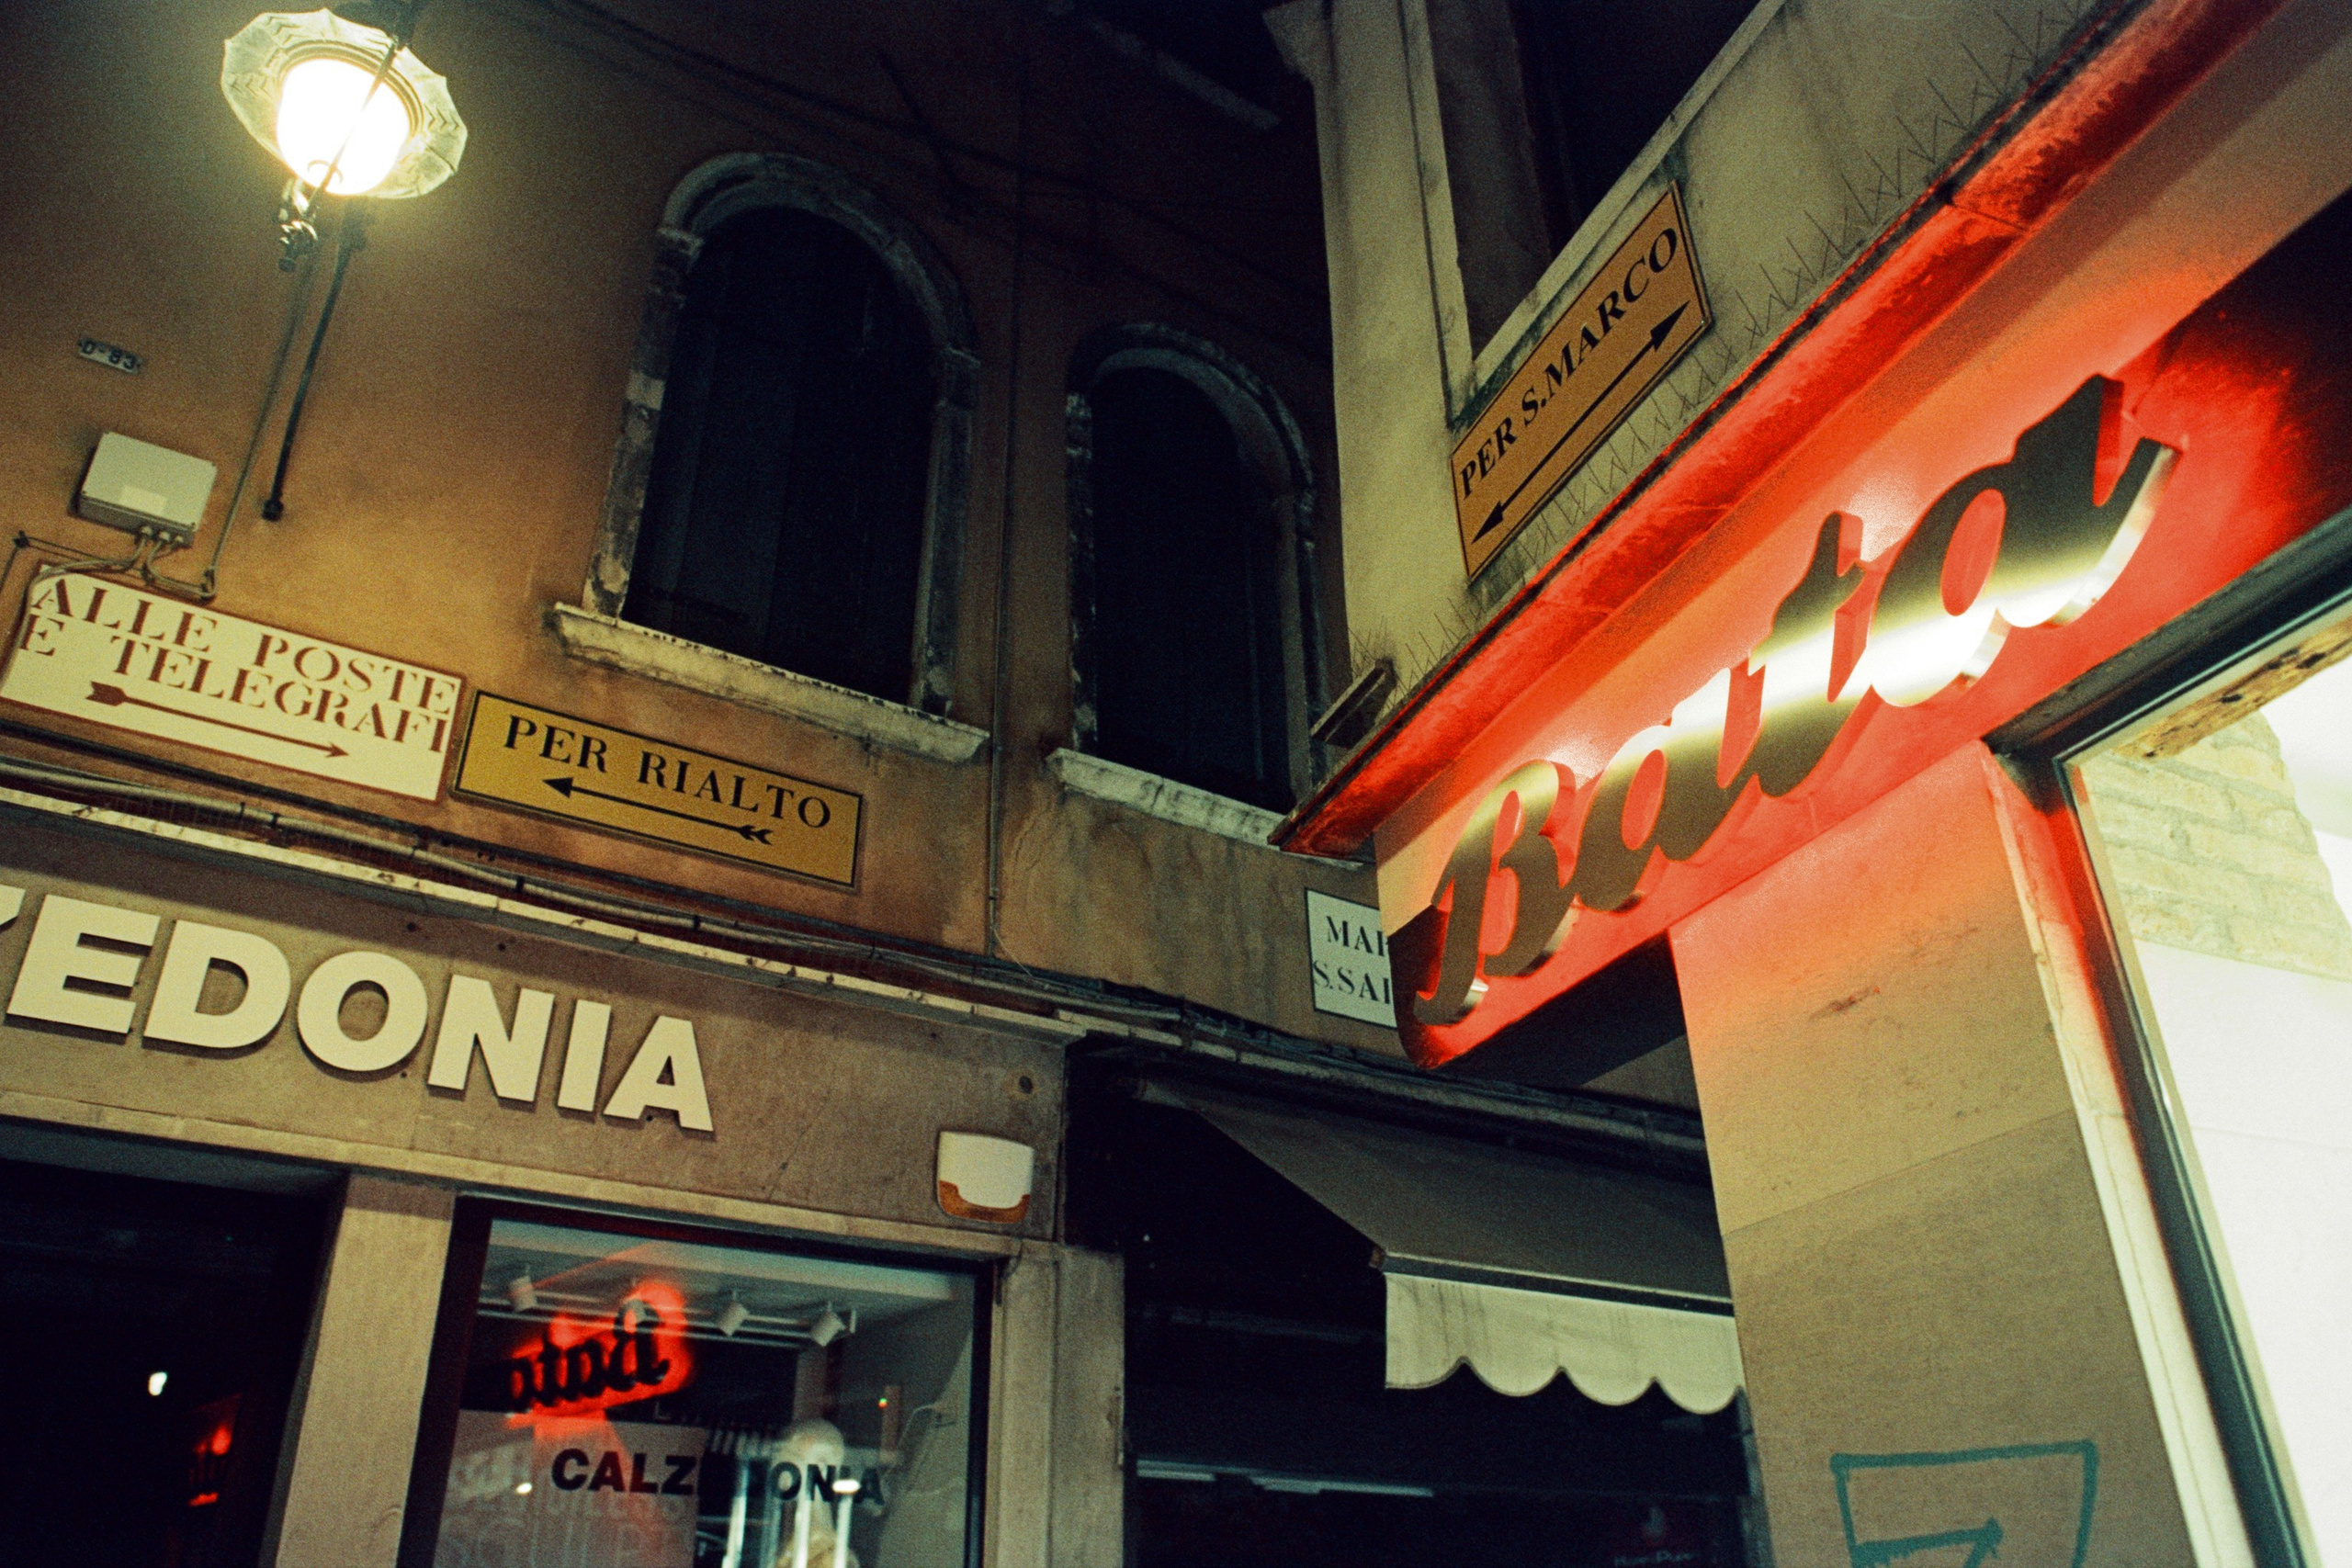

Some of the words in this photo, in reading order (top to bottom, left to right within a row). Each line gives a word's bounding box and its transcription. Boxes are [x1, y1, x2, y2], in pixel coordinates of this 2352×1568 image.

[1459, 418, 1518, 500] PER
[1521, 227, 1678, 427] S.MARCO
[18, 613, 65, 657] E
[109, 634, 453, 754] TELEGRAFI
[30, 578, 217, 652] ALLE
[251, 633, 457, 716] POSTE
[1413, 372, 2183, 1026] Bata
[503, 715, 609, 774] PER
[636, 750, 832, 829] RIALTO
[0, 884, 714, 1133] EDONIA
